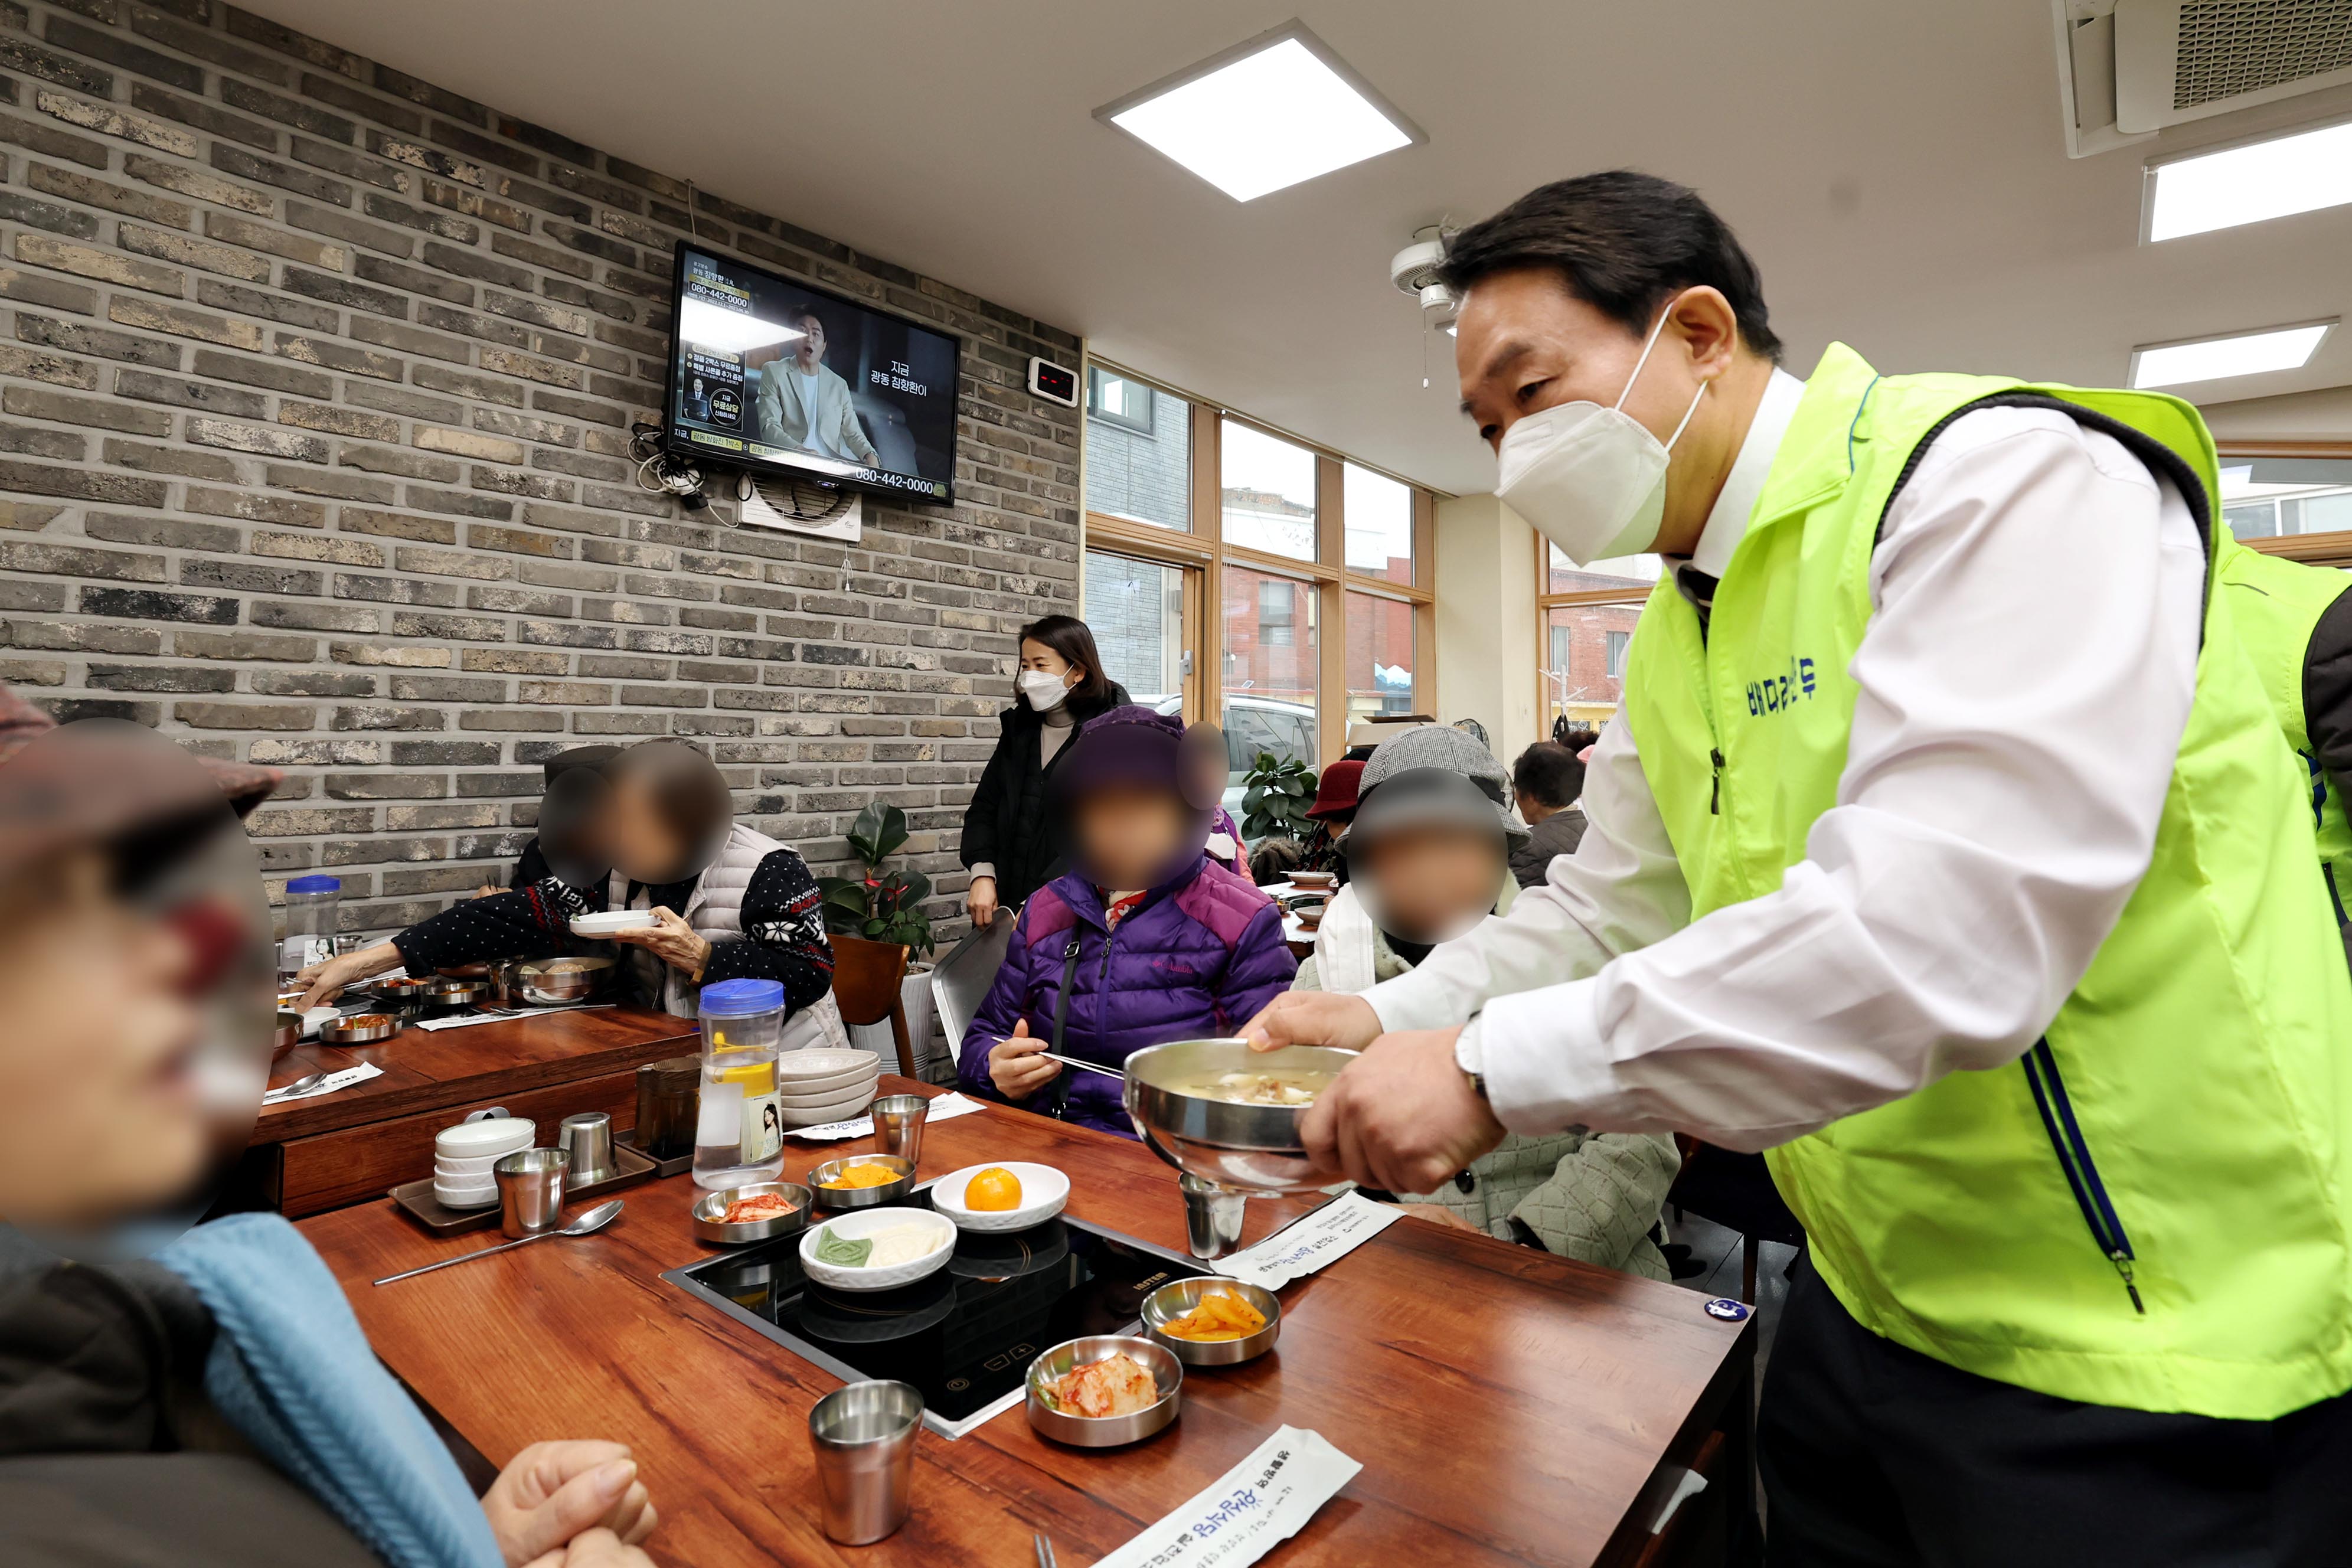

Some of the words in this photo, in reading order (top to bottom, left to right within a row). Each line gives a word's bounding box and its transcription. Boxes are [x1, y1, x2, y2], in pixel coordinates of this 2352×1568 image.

[691, 283, 747, 308] 080-442-0000
[705, 357, 720, 367] 2박스
[890, 360, 910, 377] 지금
[721, 370, 732, 379] 추가
[871, 370, 890, 387] 광동
[891, 375, 927, 397] 침향환이
[713, 399, 739, 413] 무료상담
[721, 394, 731, 402] 지금
[674, 428, 690, 440] 지금,
[693, 432, 705, 442] 광동
[725, 439, 740, 449] 1박스
[752, 445, 763, 453] 광동
[855, 467, 933, 494] 080-442-0000
[1255, 1451, 1291, 1489] 생활방역
[1193, 1489, 1257, 1538] 안심식당
